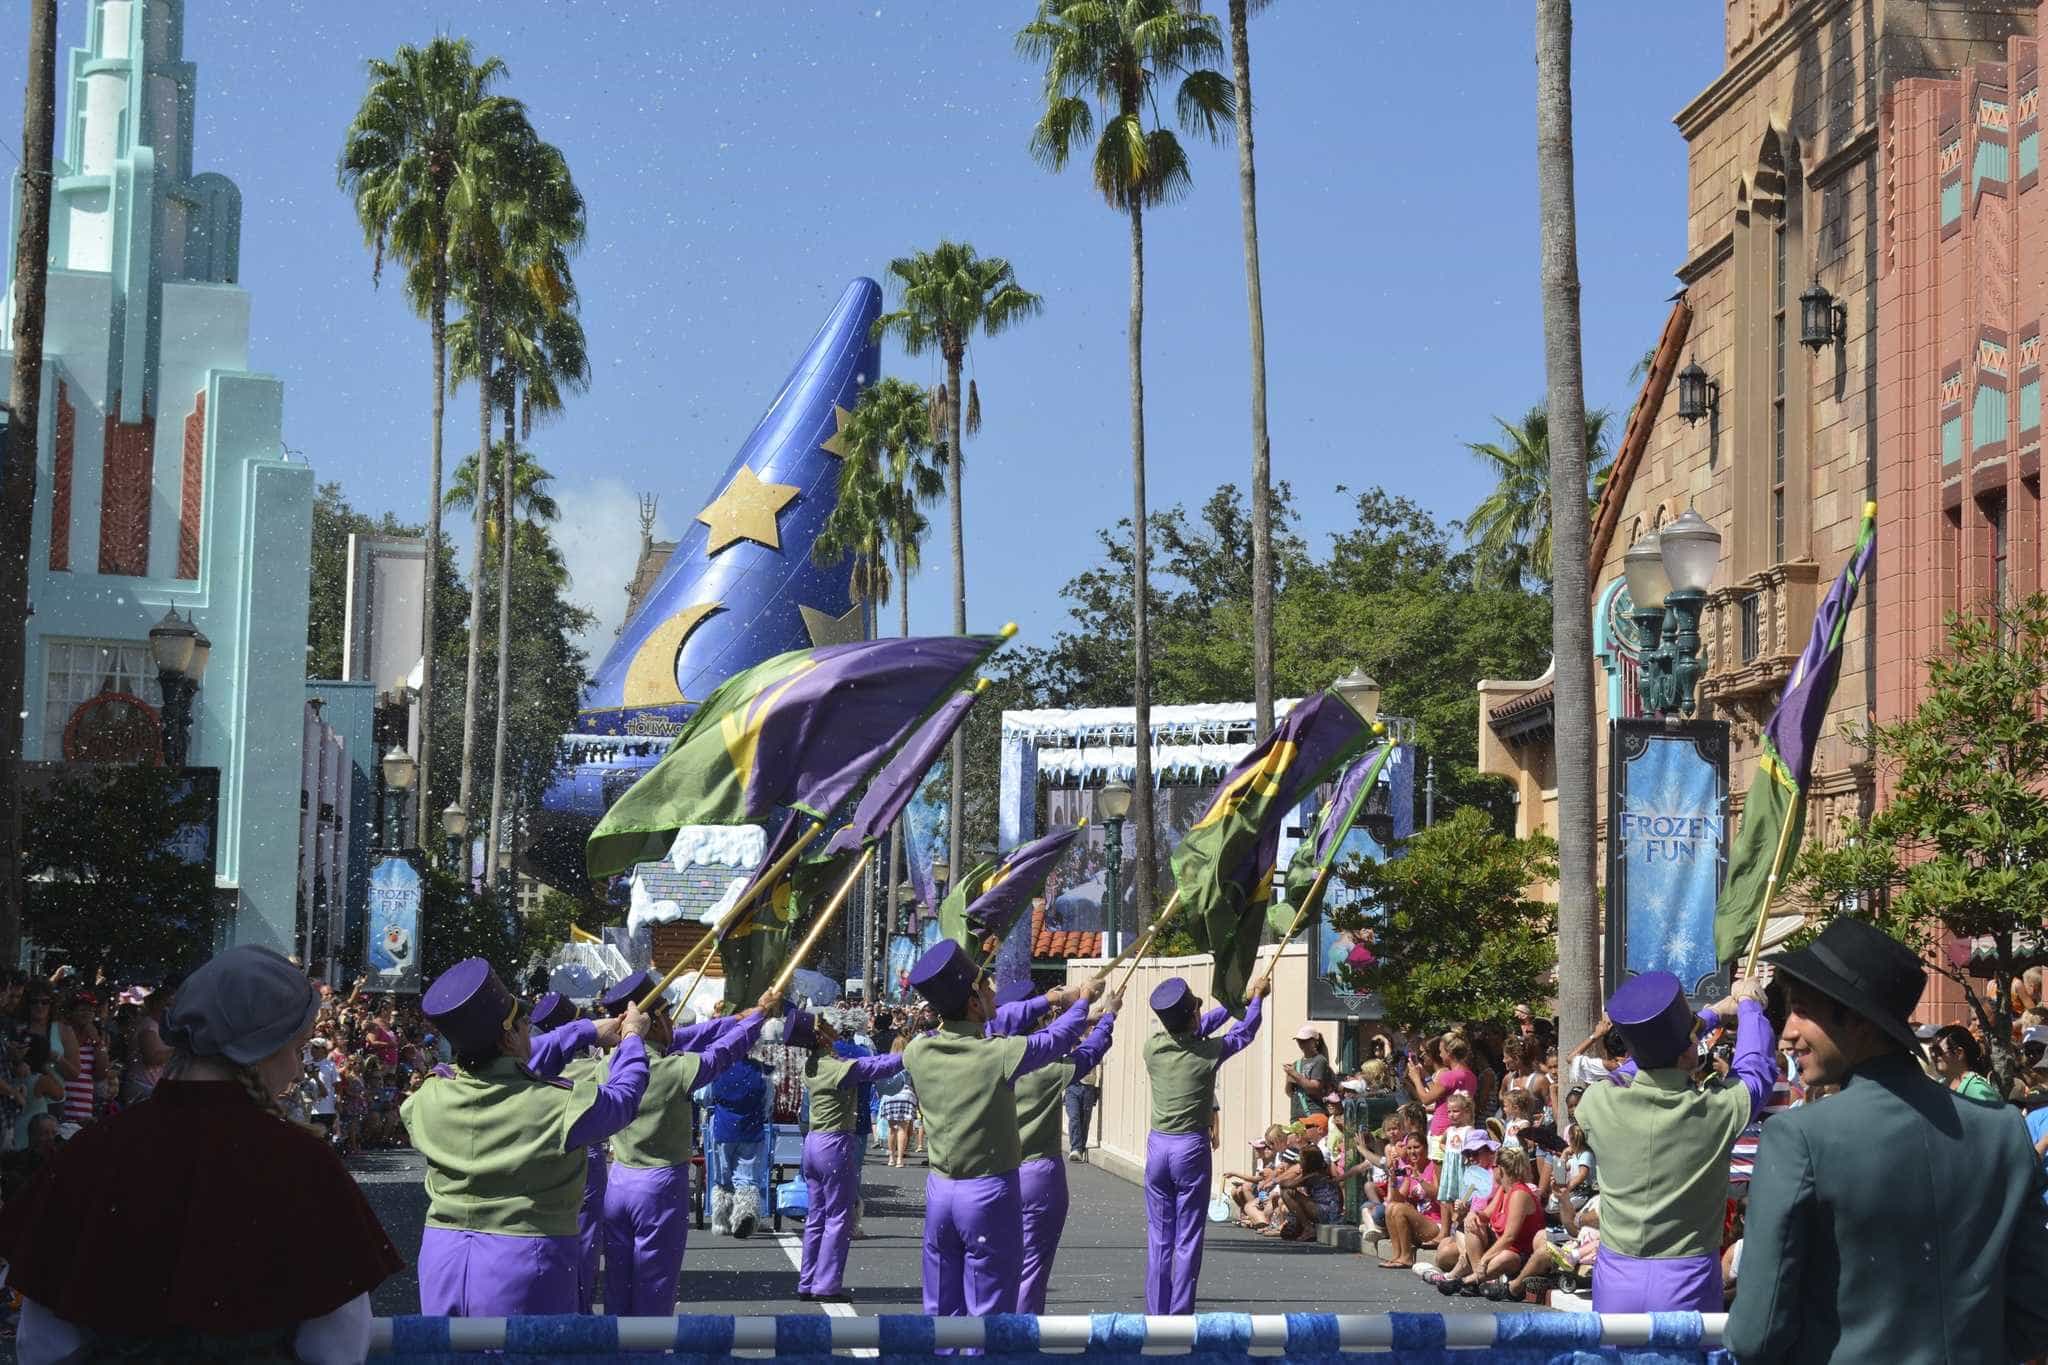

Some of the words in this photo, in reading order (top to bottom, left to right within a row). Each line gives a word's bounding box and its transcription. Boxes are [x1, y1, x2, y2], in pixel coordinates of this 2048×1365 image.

[1619, 812, 1725, 843] FROZEN
[1645, 839, 1697, 864] FUN
[368, 887, 421, 902] FROZEN
[381, 900, 407, 912] FUN
